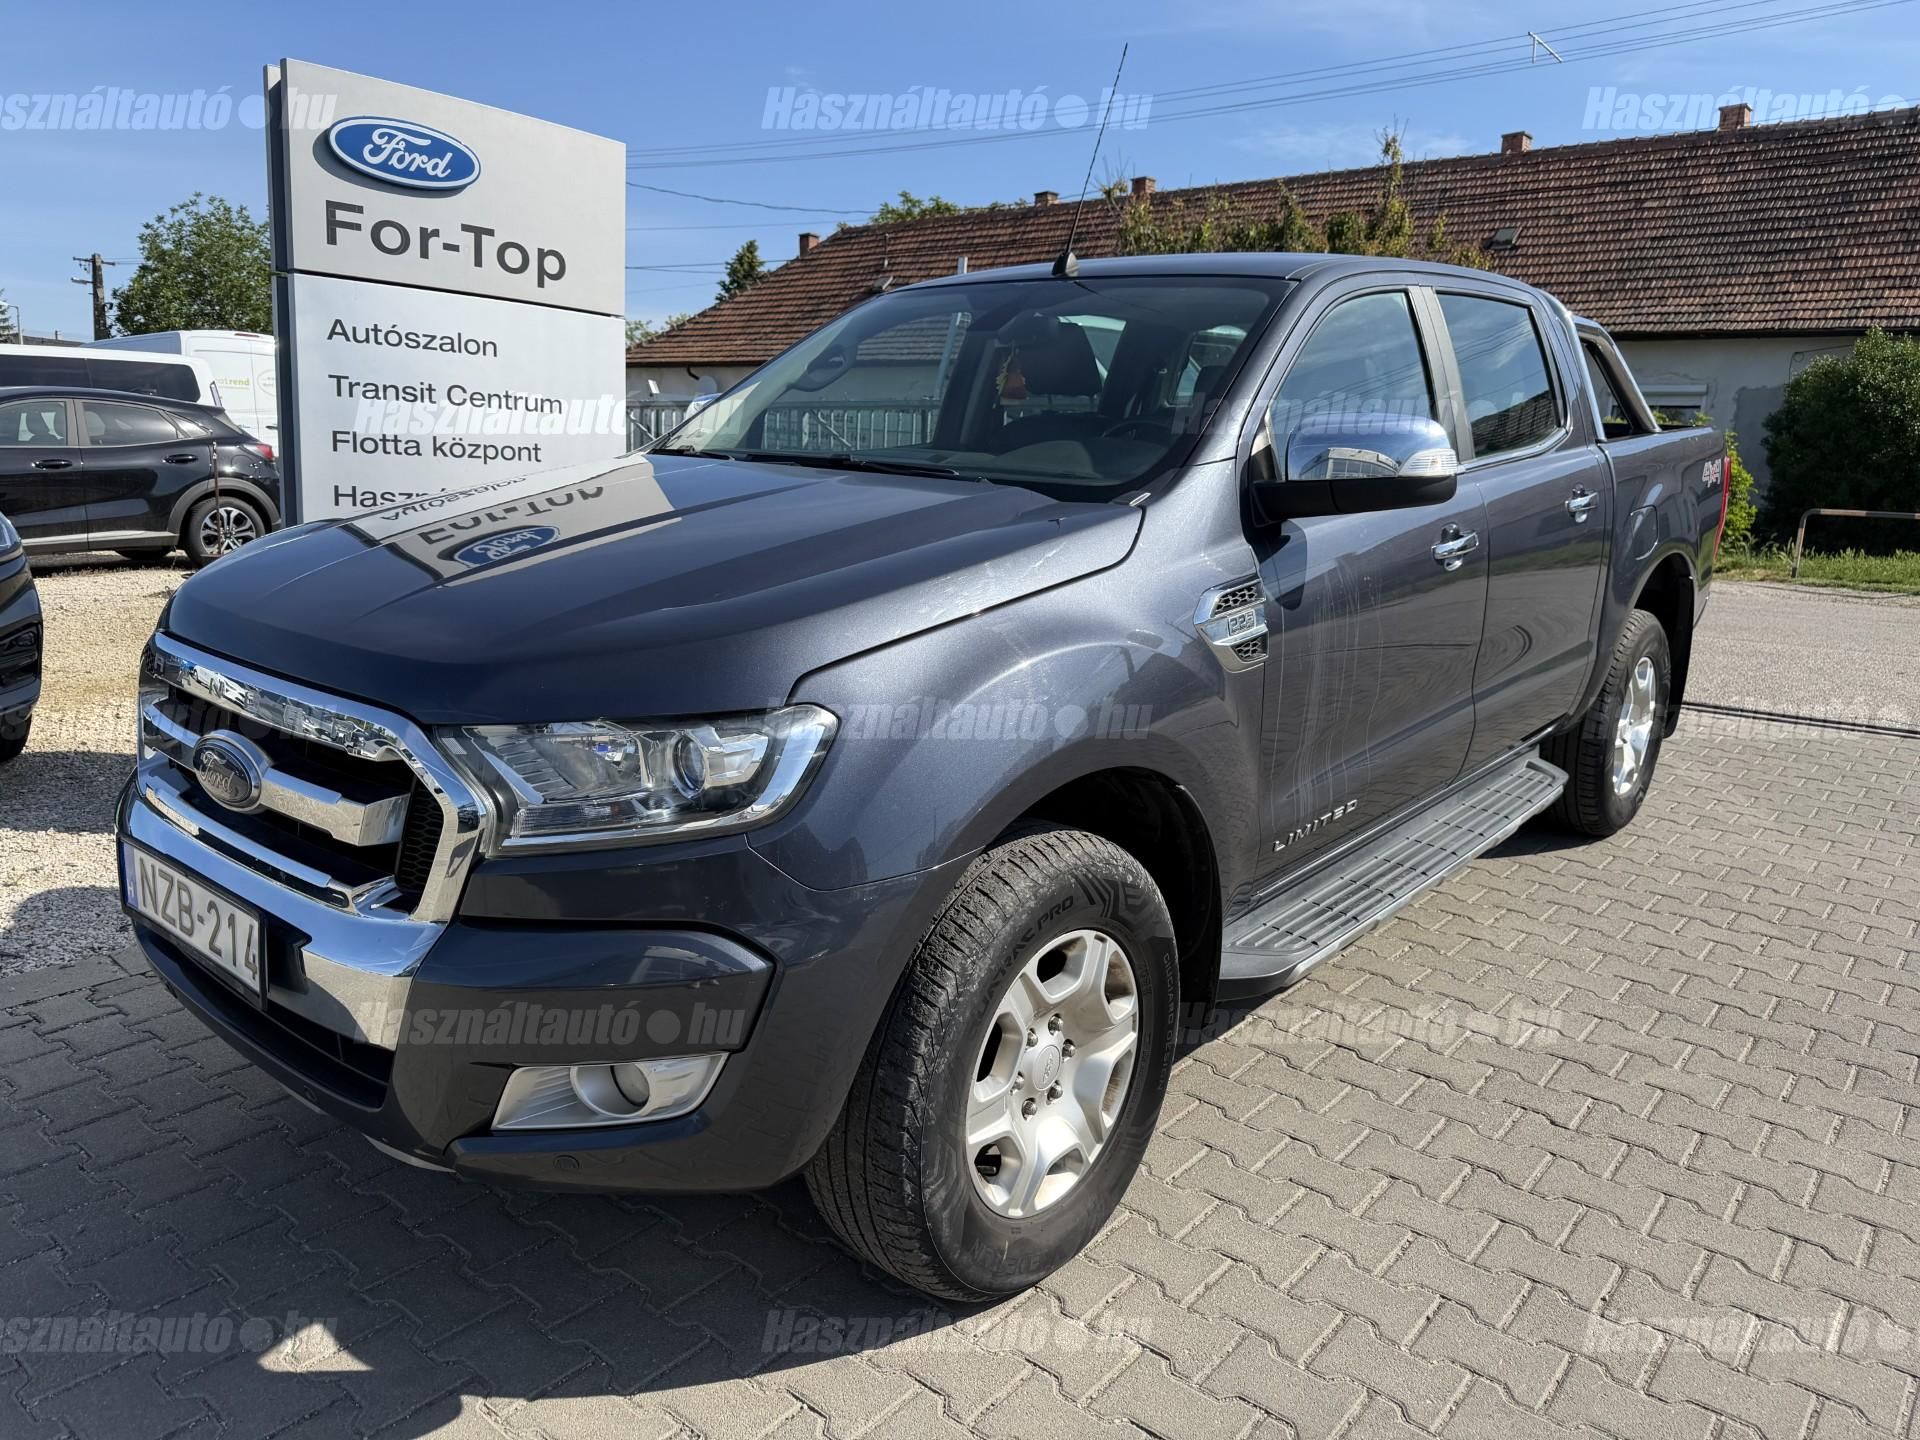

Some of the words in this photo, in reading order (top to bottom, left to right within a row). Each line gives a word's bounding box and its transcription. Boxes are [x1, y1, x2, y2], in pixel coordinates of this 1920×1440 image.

[362, 128, 453, 178] Ford
[326, 200, 567, 288] For-Top
[327, 319, 498, 357] Autószalon
[328, 374, 437, 405] Transit
[446, 385, 563, 414] Centrum
[332, 430, 422, 457] Flotta
[433, 436, 542, 464] központ
[334, 484, 447, 508] Hasz
[199, 750, 235, 794] Ford
[1272, 799, 1358, 852] LIMITED
[139, 857, 258, 981] NZB-214
[1037, 895, 1074, 931] PRO
